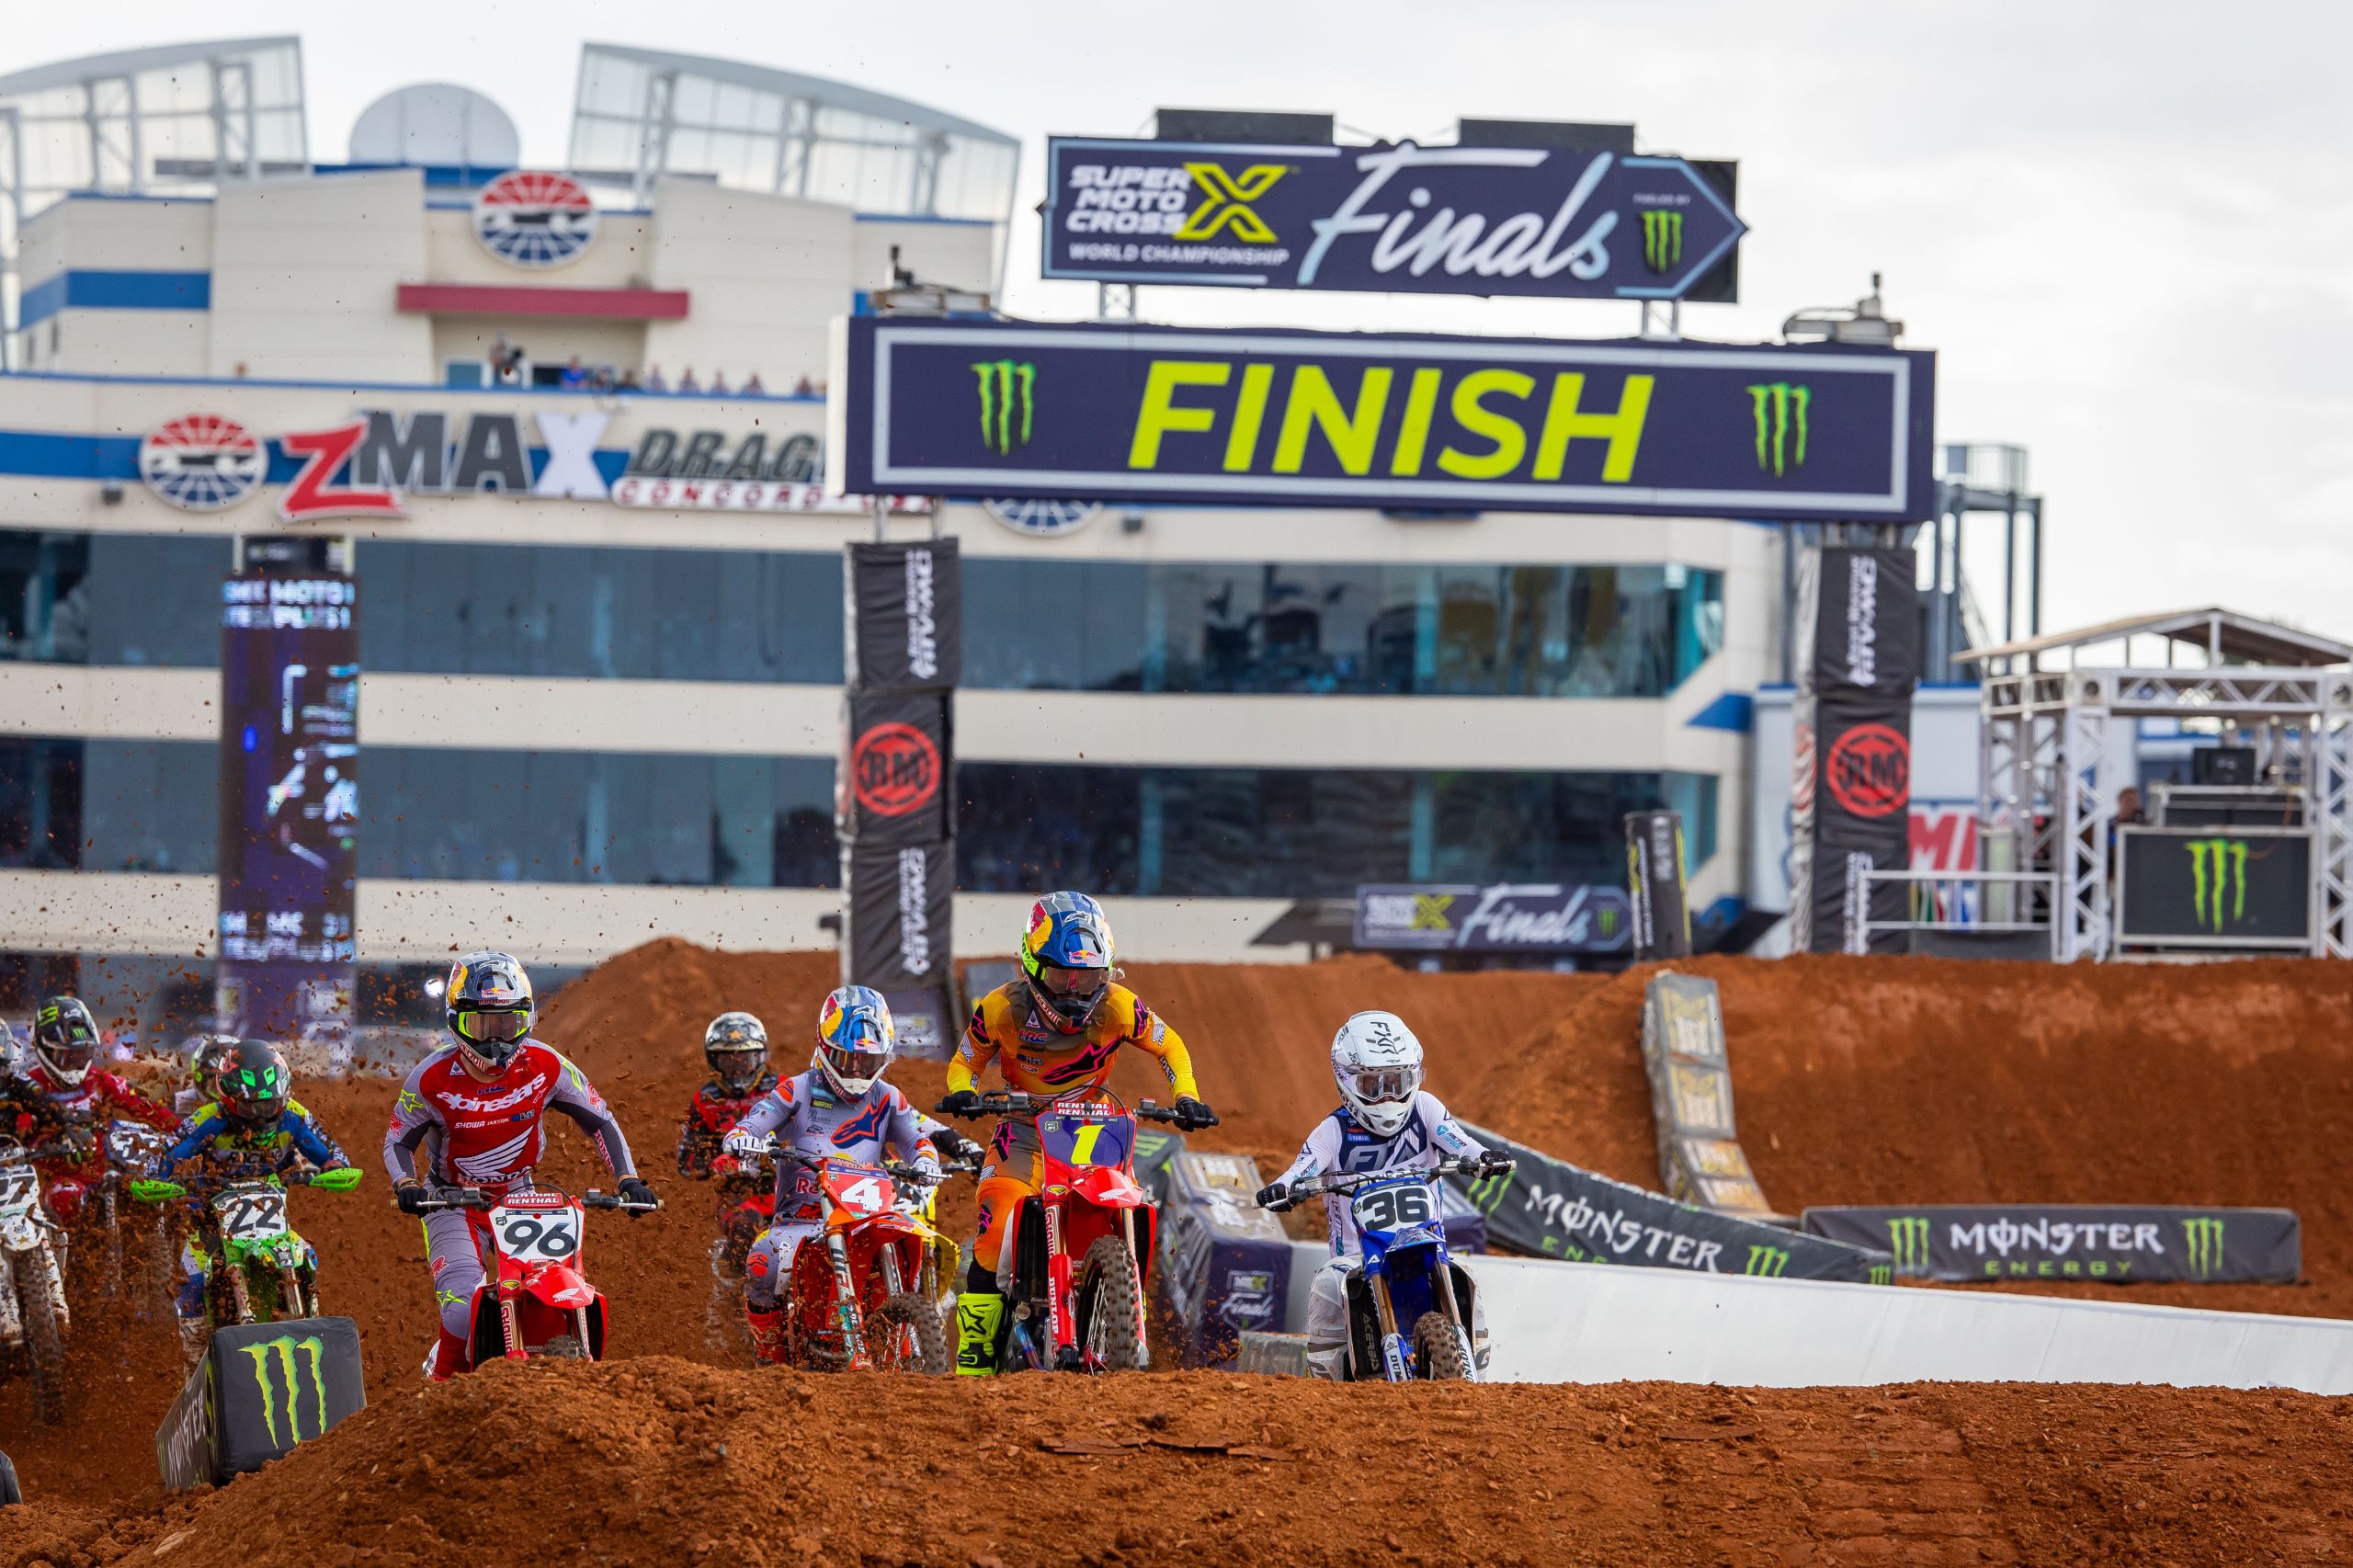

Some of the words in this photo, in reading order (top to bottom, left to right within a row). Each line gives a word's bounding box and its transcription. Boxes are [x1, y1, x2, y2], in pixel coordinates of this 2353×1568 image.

[1069, 165, 1191, 190] SUPER
[1075, 187, 1187, 212] MOTO
[1297, 144, 1619, 286] Finals
[1065, 210, 1188, 235] CROSS
[1069, 243, 1140, 262] WORLD
[1141, 244, 1290, 266] CHAMPIONSHIP
[1127, 360, 1654, 483] FINISH
[626, 429, 824, 483] DRAG
[1456, 882, 1592, 948] Finals
[1018, 1029, 1047, 1044] HRC
[437, 1073, 546, 1113] alpinestars
[454, 1120, 485, 1129] SHOWA
[487, 1118, 509, 1126] JAXXON
[1071, 1125, 1106, 1165] 1
[797, 1176, 818, 1195] Re
[841, 1177, 882, 1212] 4
[226, 1197, 280, 1234] 22
[1362, 1187, 1429, 1231] 36
[504, 1220, 575, 1257] 96
[1525, 1185, 1723, 1273] MONSTER
[1949, 1216, 2165, 1256] MONSTER
[1984, 1259, 2133, 1277] ENERGY
[1048, 1277, 1059, 1335] DUNLOP
[1389, 1354, 1405, 1382] DUN
[167, 1390, 207, 1485] MONSTER
